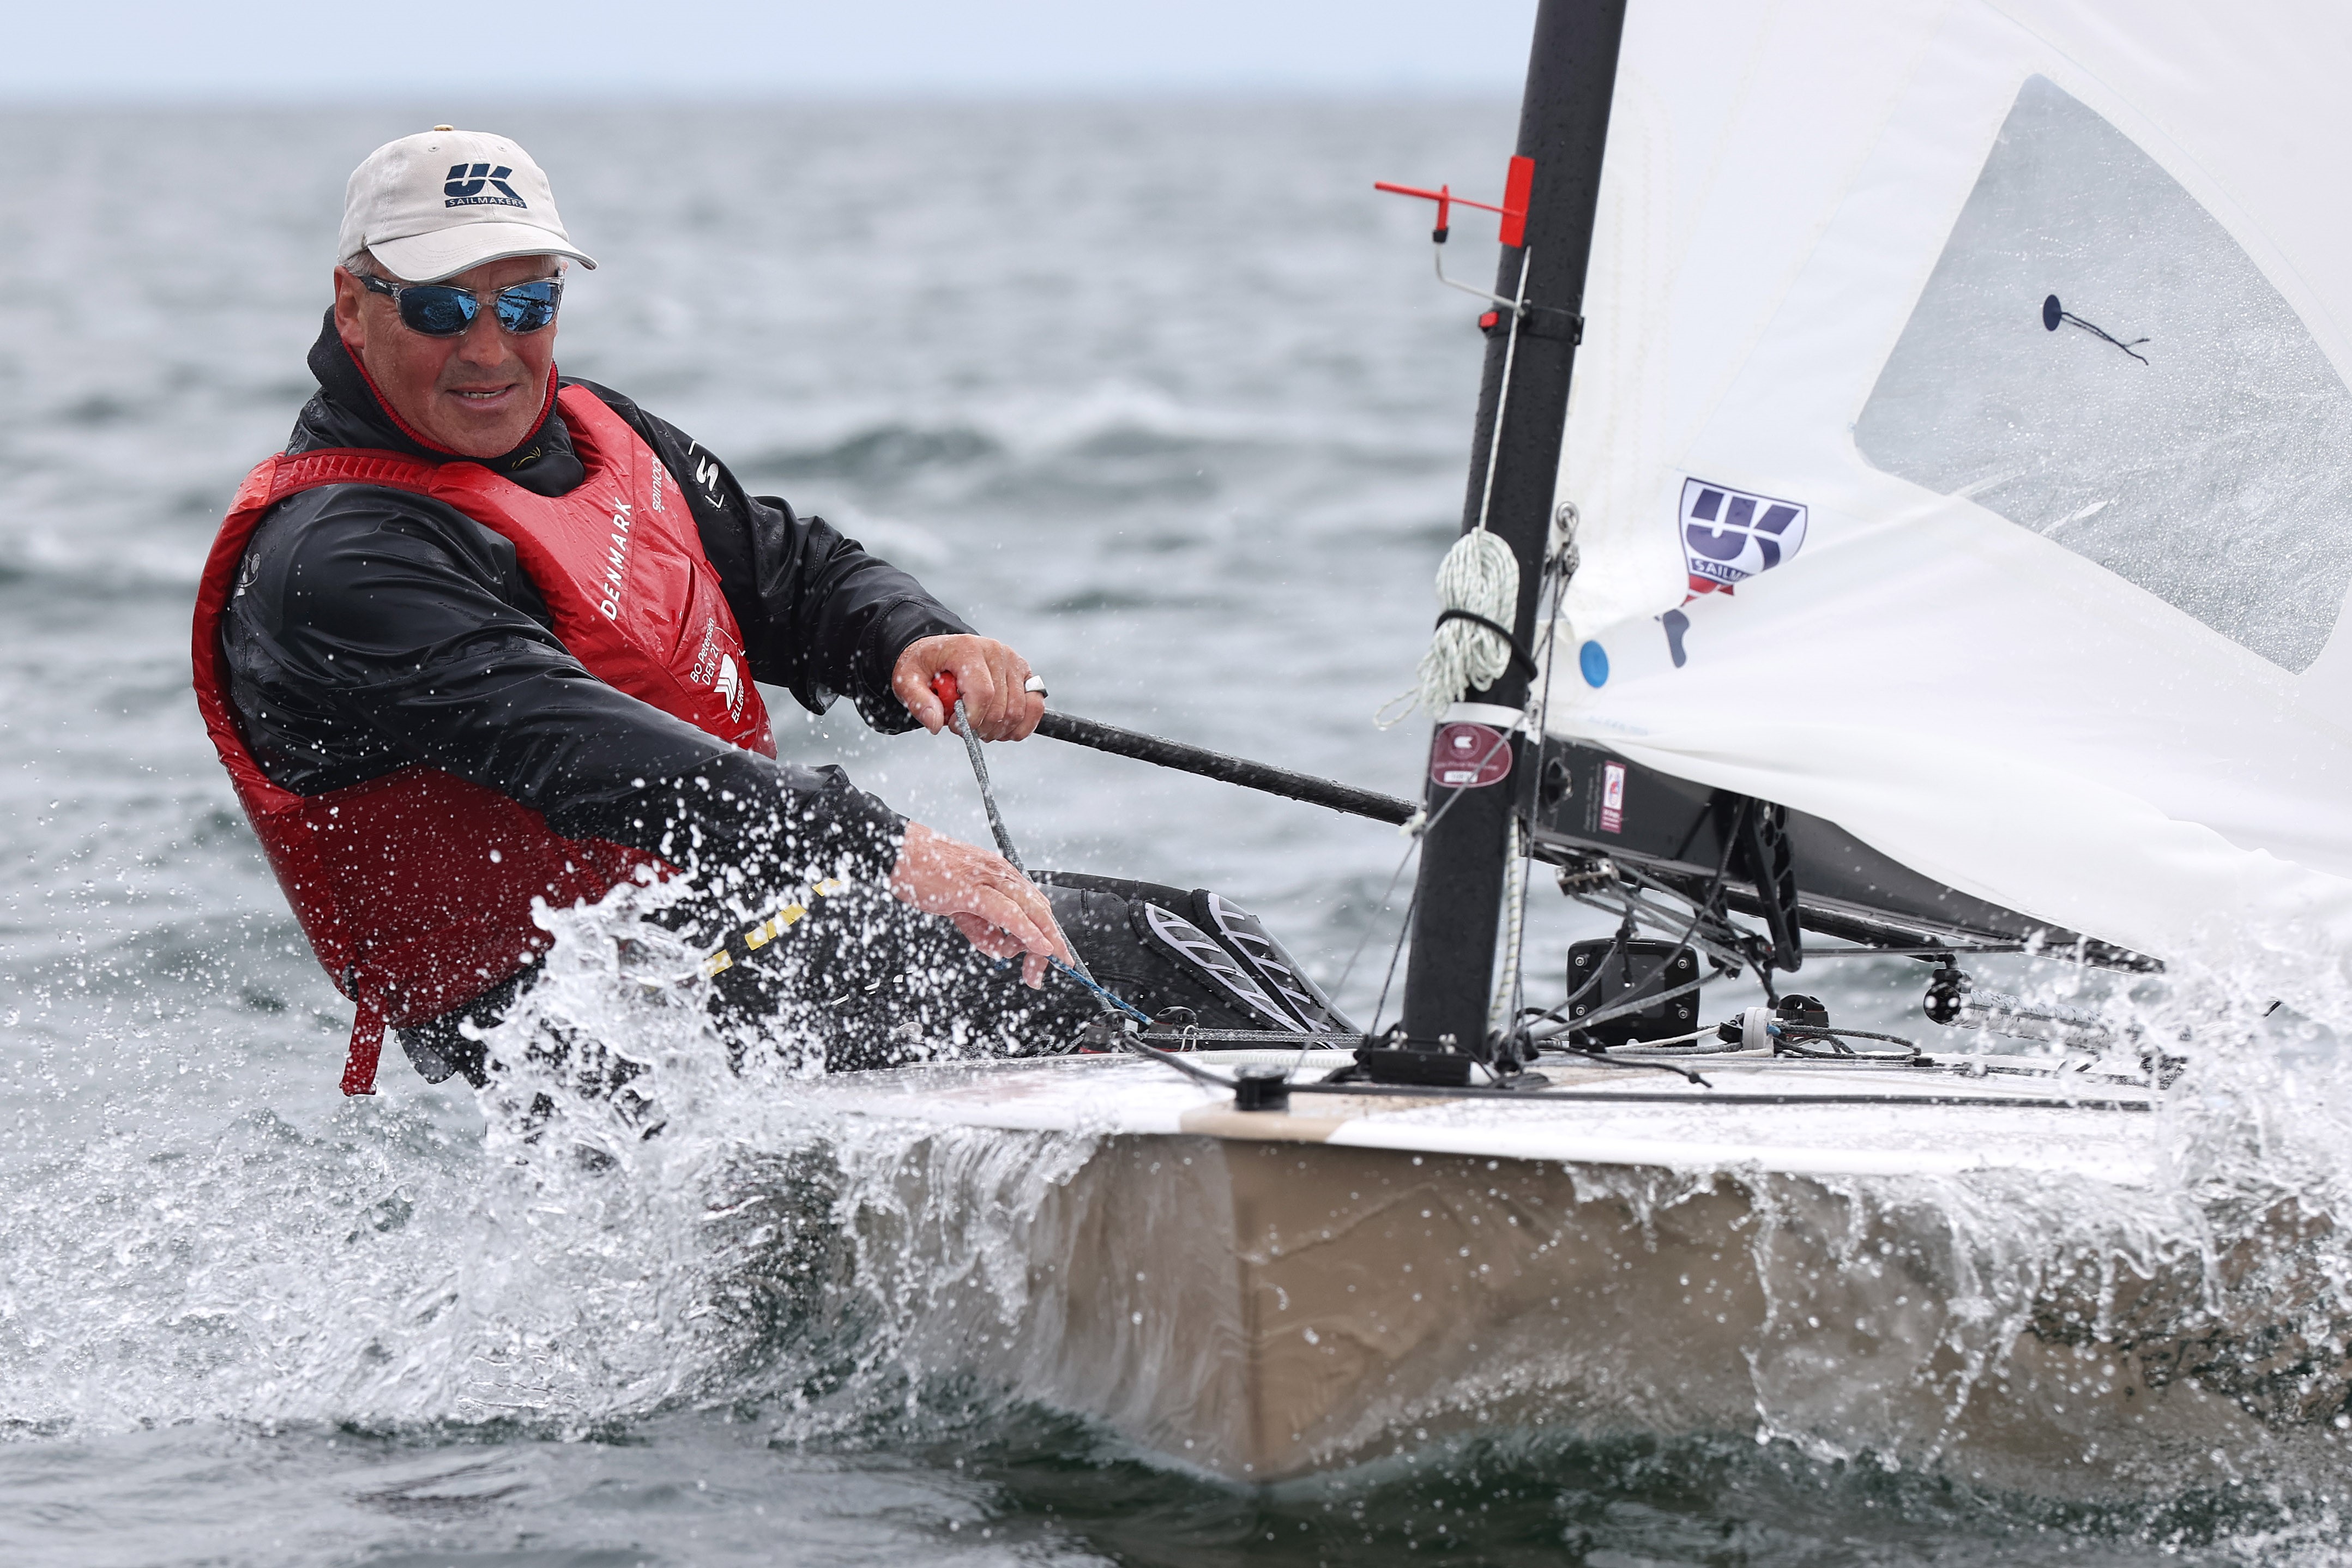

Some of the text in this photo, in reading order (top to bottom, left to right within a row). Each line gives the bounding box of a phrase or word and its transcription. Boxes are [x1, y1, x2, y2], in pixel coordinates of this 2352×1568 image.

[449, 197, 524, 207] SAILMAKERS
[600, 497, 632, 621] DENMARK
[1694, 559, 1749, 581] SAILM
[690, 617, 715, 683] BO Petersen
[701, 642, 720, 686] DEN 21
